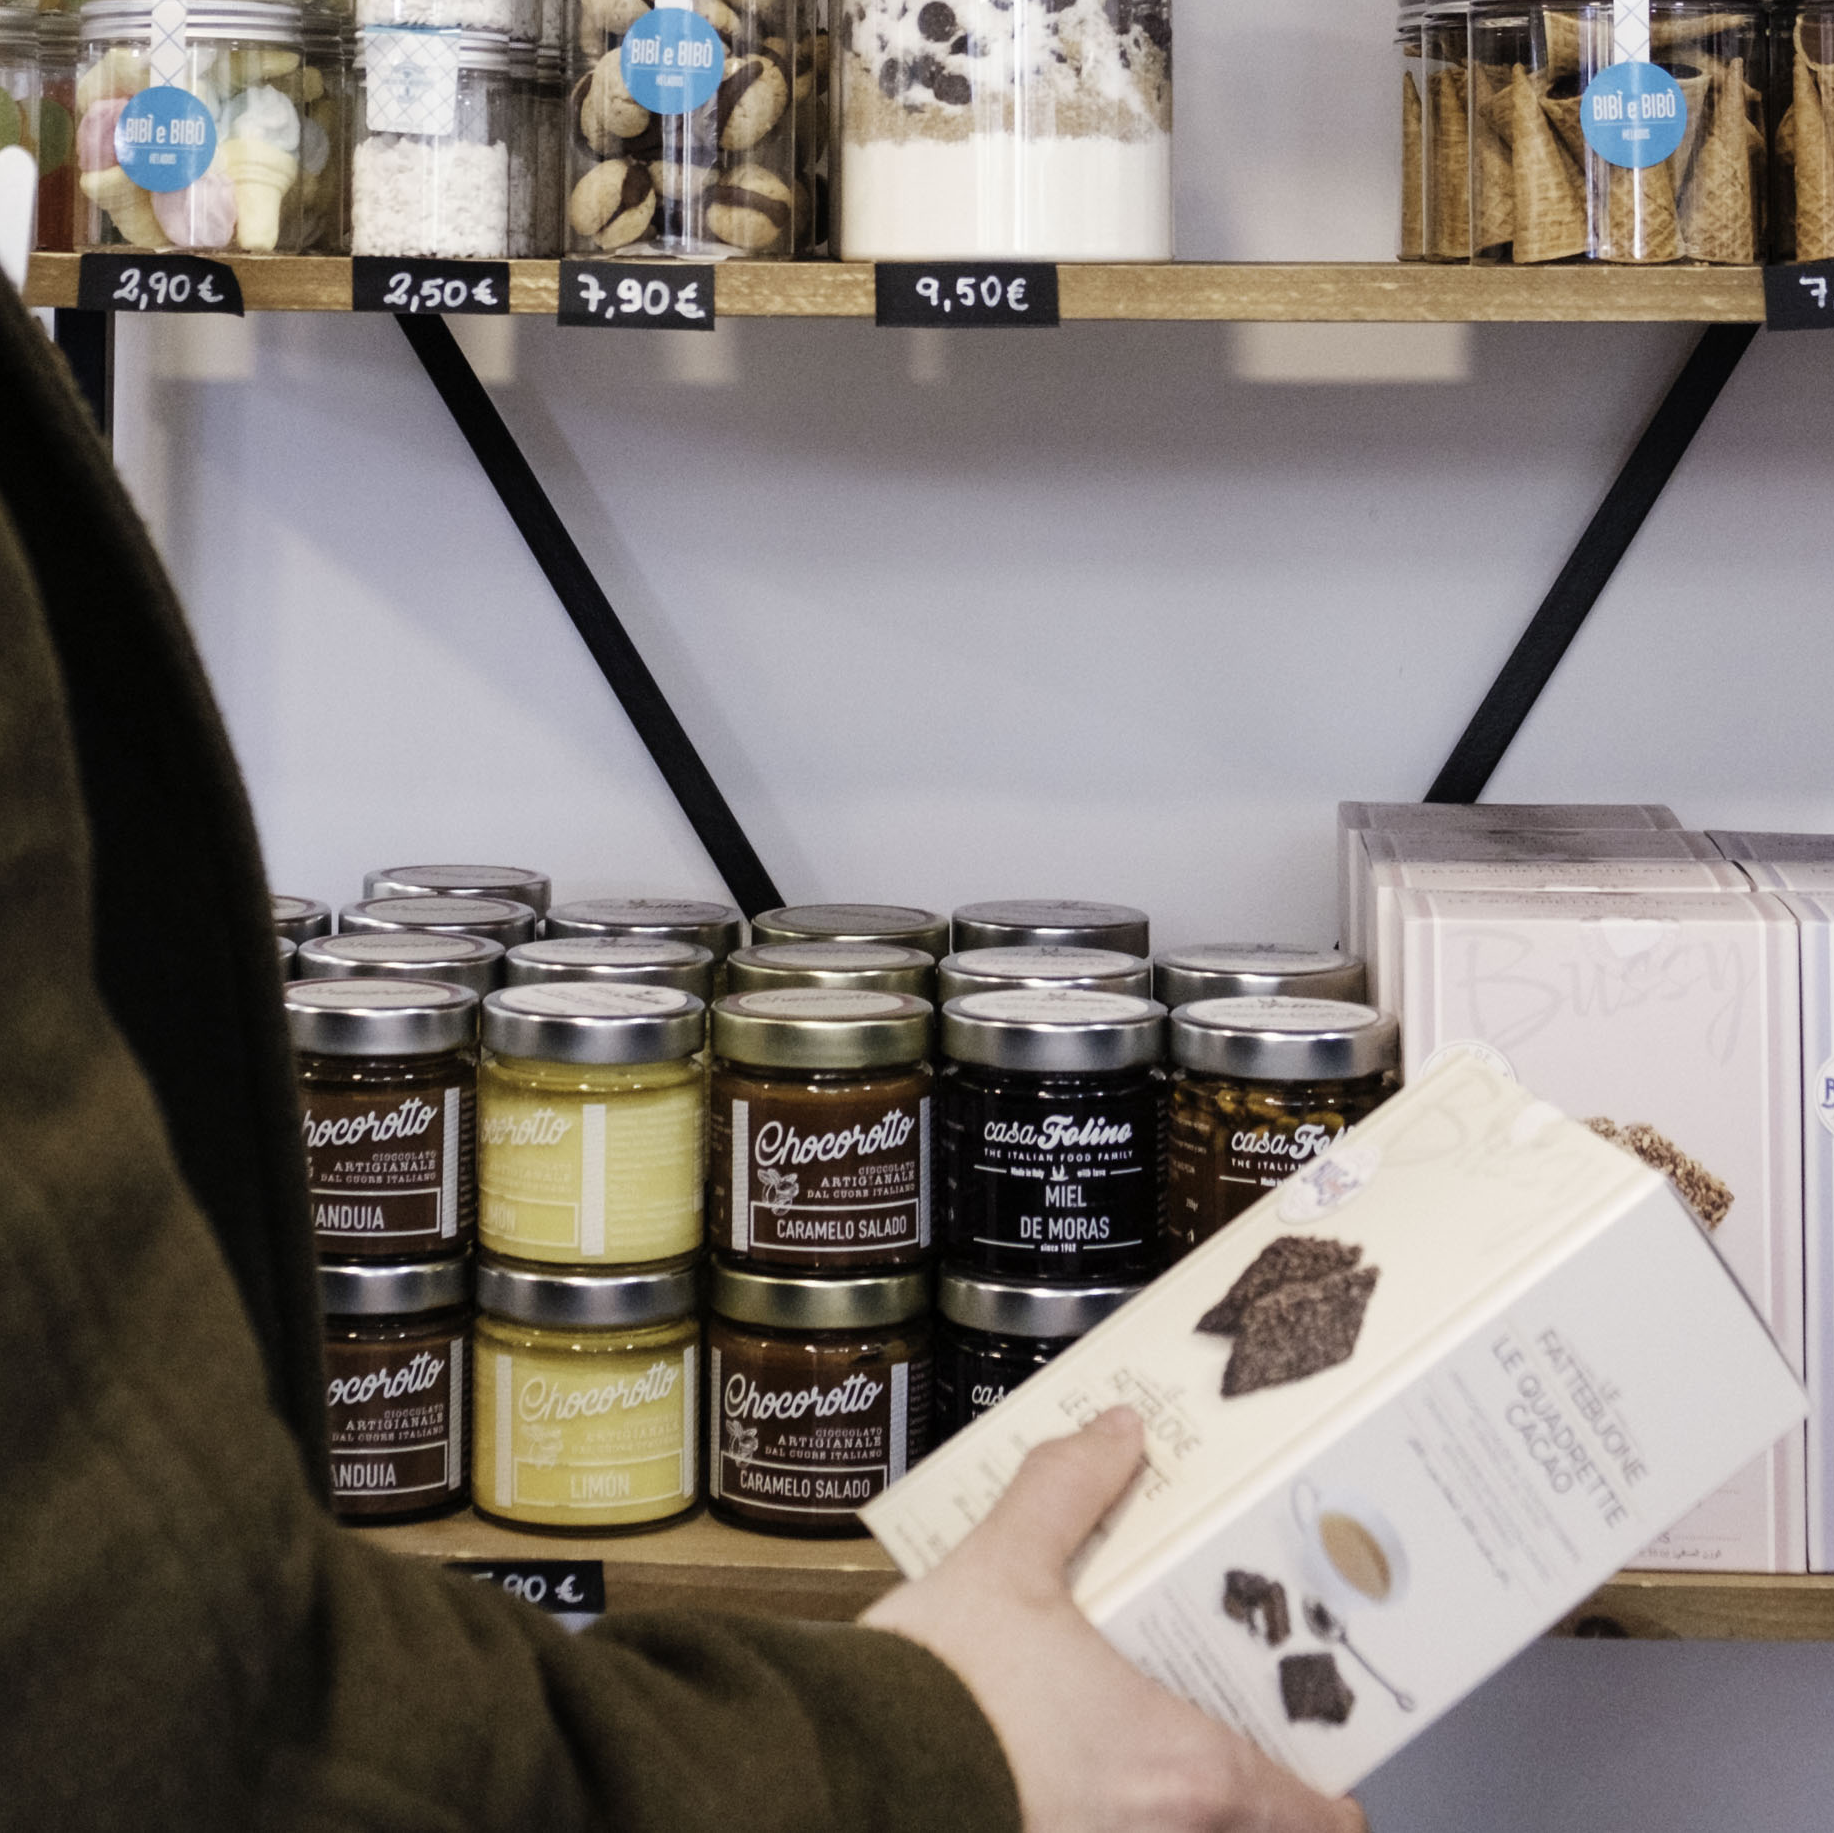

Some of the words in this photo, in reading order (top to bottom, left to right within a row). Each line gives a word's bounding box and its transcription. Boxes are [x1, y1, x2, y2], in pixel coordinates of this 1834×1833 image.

[631, 34, 662, 65] BIBÌ
[663, 47, 674, 66] e
[677, 38, 714, 68] BIBÒ
[1593, 89, 1623, 121] BIBÌ
[1627, 101, 1638, 120] e
[1641, 88, 1676, 119] BIBÒ
[126, 114, 155, 144] BIBÌ
[156, 125, 167, 144] e
[169, 116, 206, 146] BIBÒ
[755, 1107, 916, 1167] Chocorotto
[983, 1120, 1037, 1145] casa
[1037, 1114, 1134, 1150] Folino
[1231, 1130, 1290, 1155] casa
[333, 1159, 437, 1173] ARTIGIANALE
[372, 1151, 437, 1162] CIOCCOLATO
[984, 1147, 1002, 1159] THE
[1007, 1151, 1054, 1163] ITALIAN
[1060, 1153, 1092, 1163] FOOD
[1097, 1149, 1134, 1162] FAMILY
[320, 1173, 342, 1183] DAL
[345, 1175, 384, 1184] CUORE
[386, 1172, 437, 1184] ITALIANO
[820, 1170, 916, 1188] ARTIGIANALE
[858, 1161, 916, 1176] CIOCCOLATO
[806, 1189, 830, 1199] DAL
[833, 1189, 869, 1199] CUORE
[872, 1182, 916, 1197] ITALIANO
[1045, 1185, 1087, 1208] MIEL
[776, 1218, 855, 1240] CARAMELO
[858, 1215, 907, 1239] SALADO
[1019, 1216, 1043, 1240] DE
[1048, 1216, 1110, 1240] MORAS
[1040, 1243, 1059, 1253] since
[519, 1359, 679, 1423] Chocorotto
[724, 1372, 884, 1419] Chocorotto
[383, 1404, 445, 1419] CIOCCOLATO
[1537, 1327, 1650, 1488] FATTEBUONE
[331, 1432, 354, 1442] DAL
[398, 1424, 445, 1441] ITALIANO
[344, 1413, 445, 1432] ARTIGIANALE
[815, 1426, 883, 1437] CIOCCOLATO
[1491, 1333, 1526, 1375] LE
[1517, 1374, 1630, 1530] QUADRETTE
[764, 1445, 786, 1457] DAL
[789, 1450, 827, 1460] CUORE
[830, 1449, 883, 1461] ITALIANO
[777, 1434, 883, 1449] ARTIGIANALE
[1505, 1401, 1574, 1495] CACAO
[570, 1470, 631, 1500] LIMÓN
[739, 1469, 811, 1498] CARAMELO
[815, 1479, 871, 1499] SALADO
